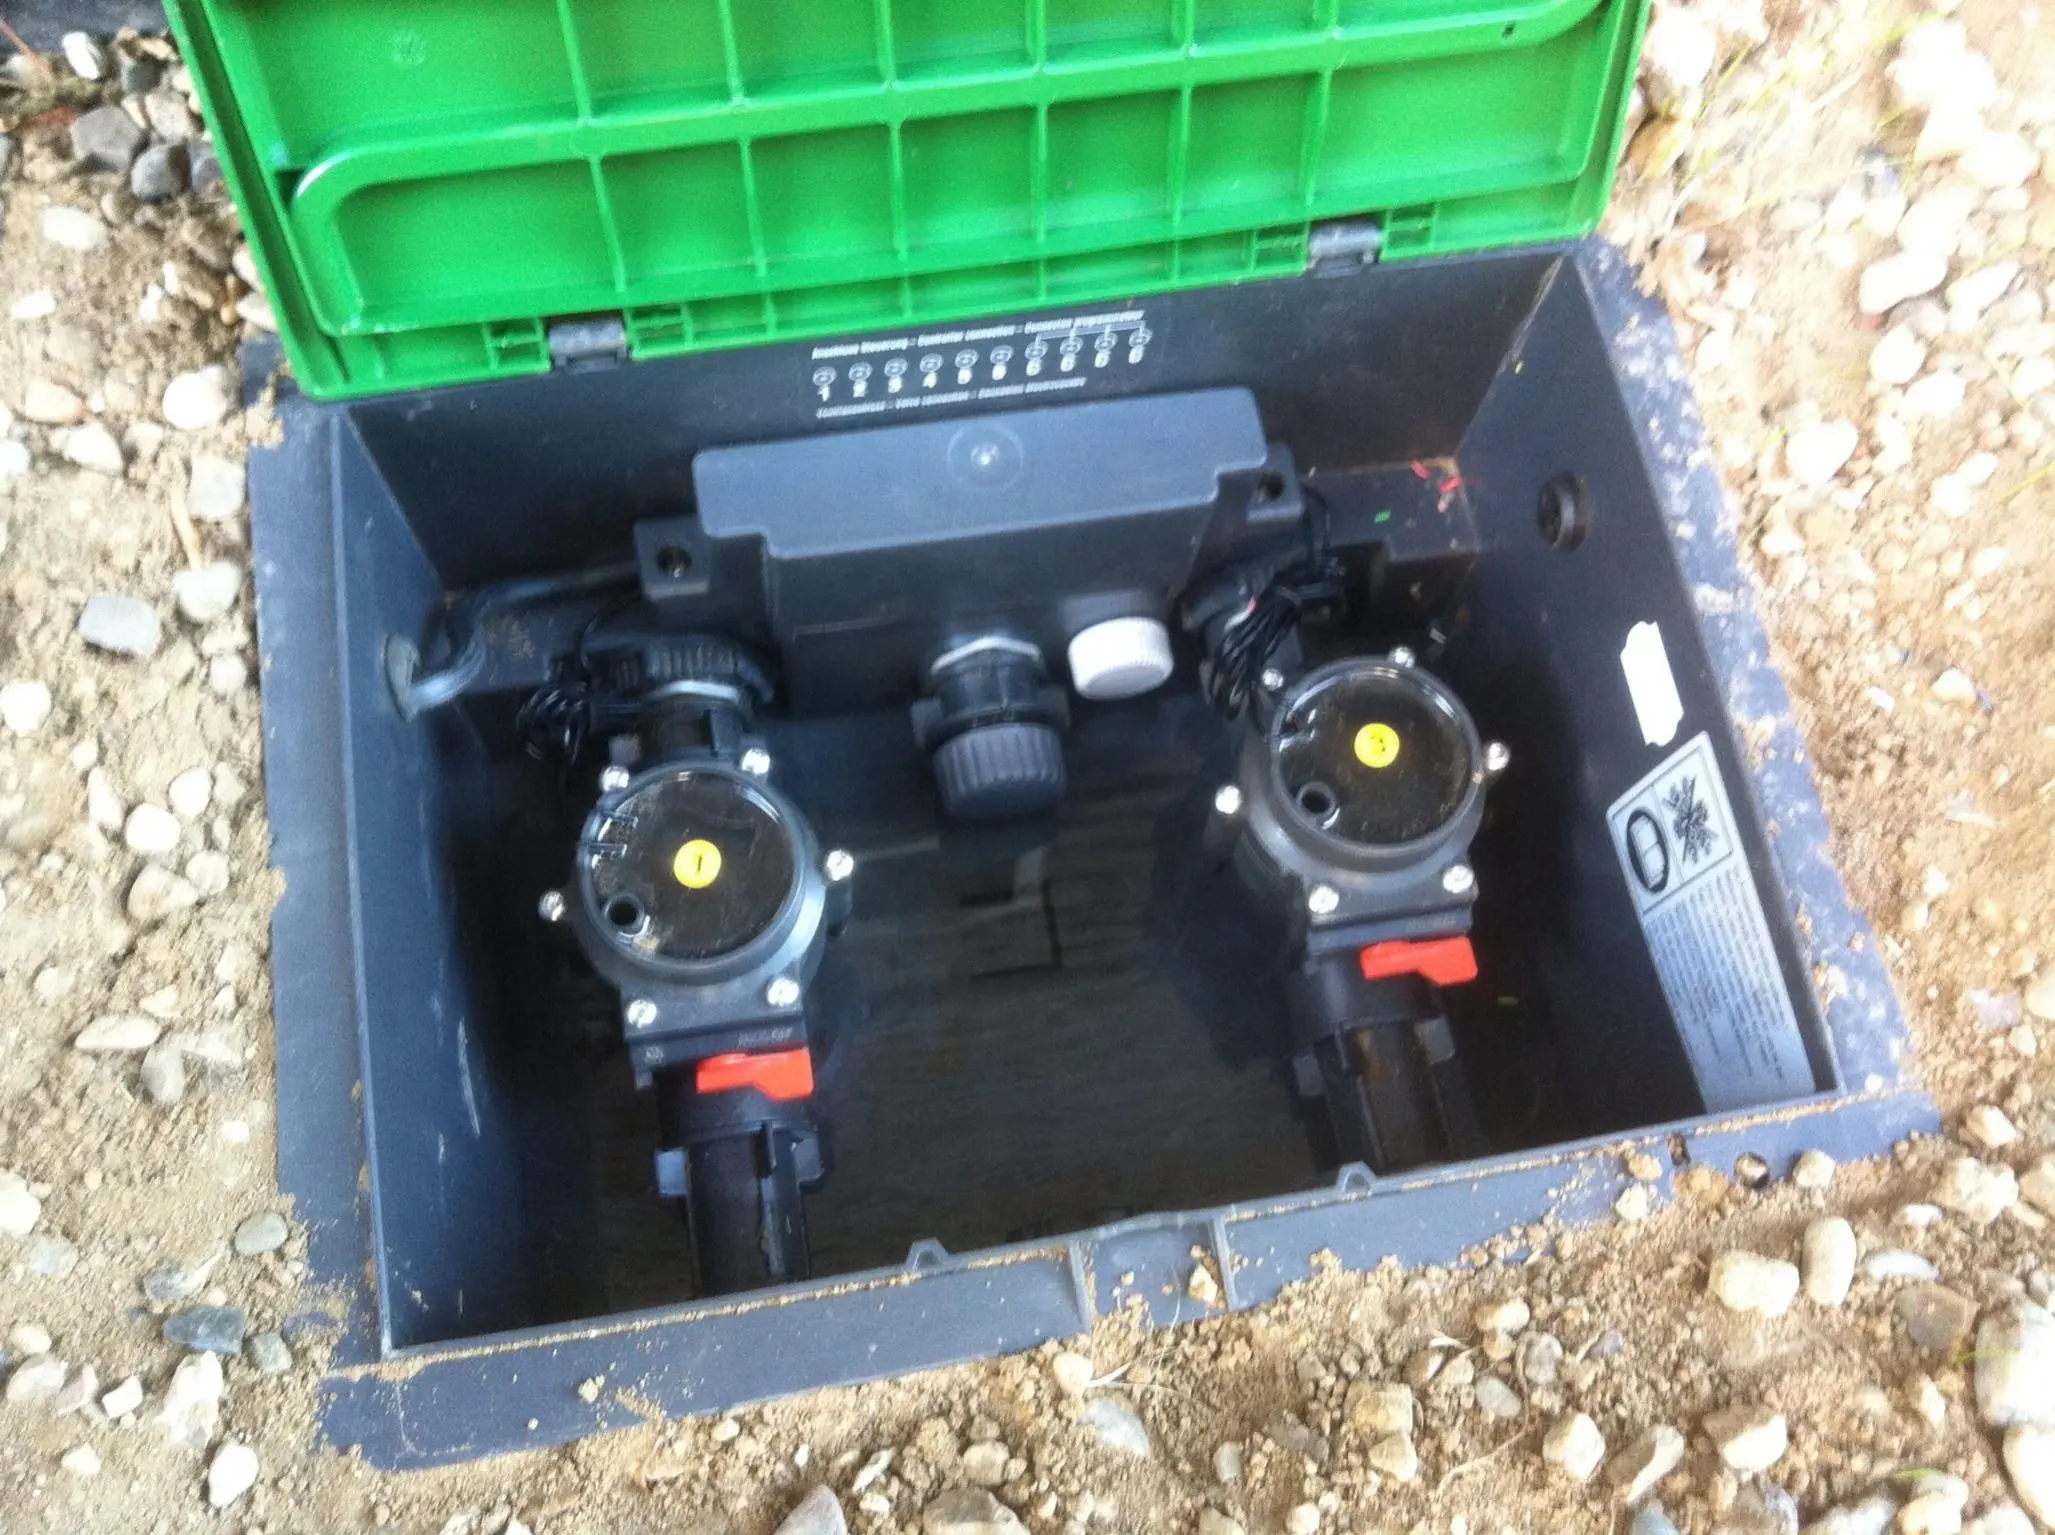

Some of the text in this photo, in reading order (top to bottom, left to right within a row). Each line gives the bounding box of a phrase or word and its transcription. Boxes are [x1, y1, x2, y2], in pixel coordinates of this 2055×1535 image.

[817, 386, 830, 401] 1
[853, 381, 867, 398] 2
[923, 372, 937, 388] 4
